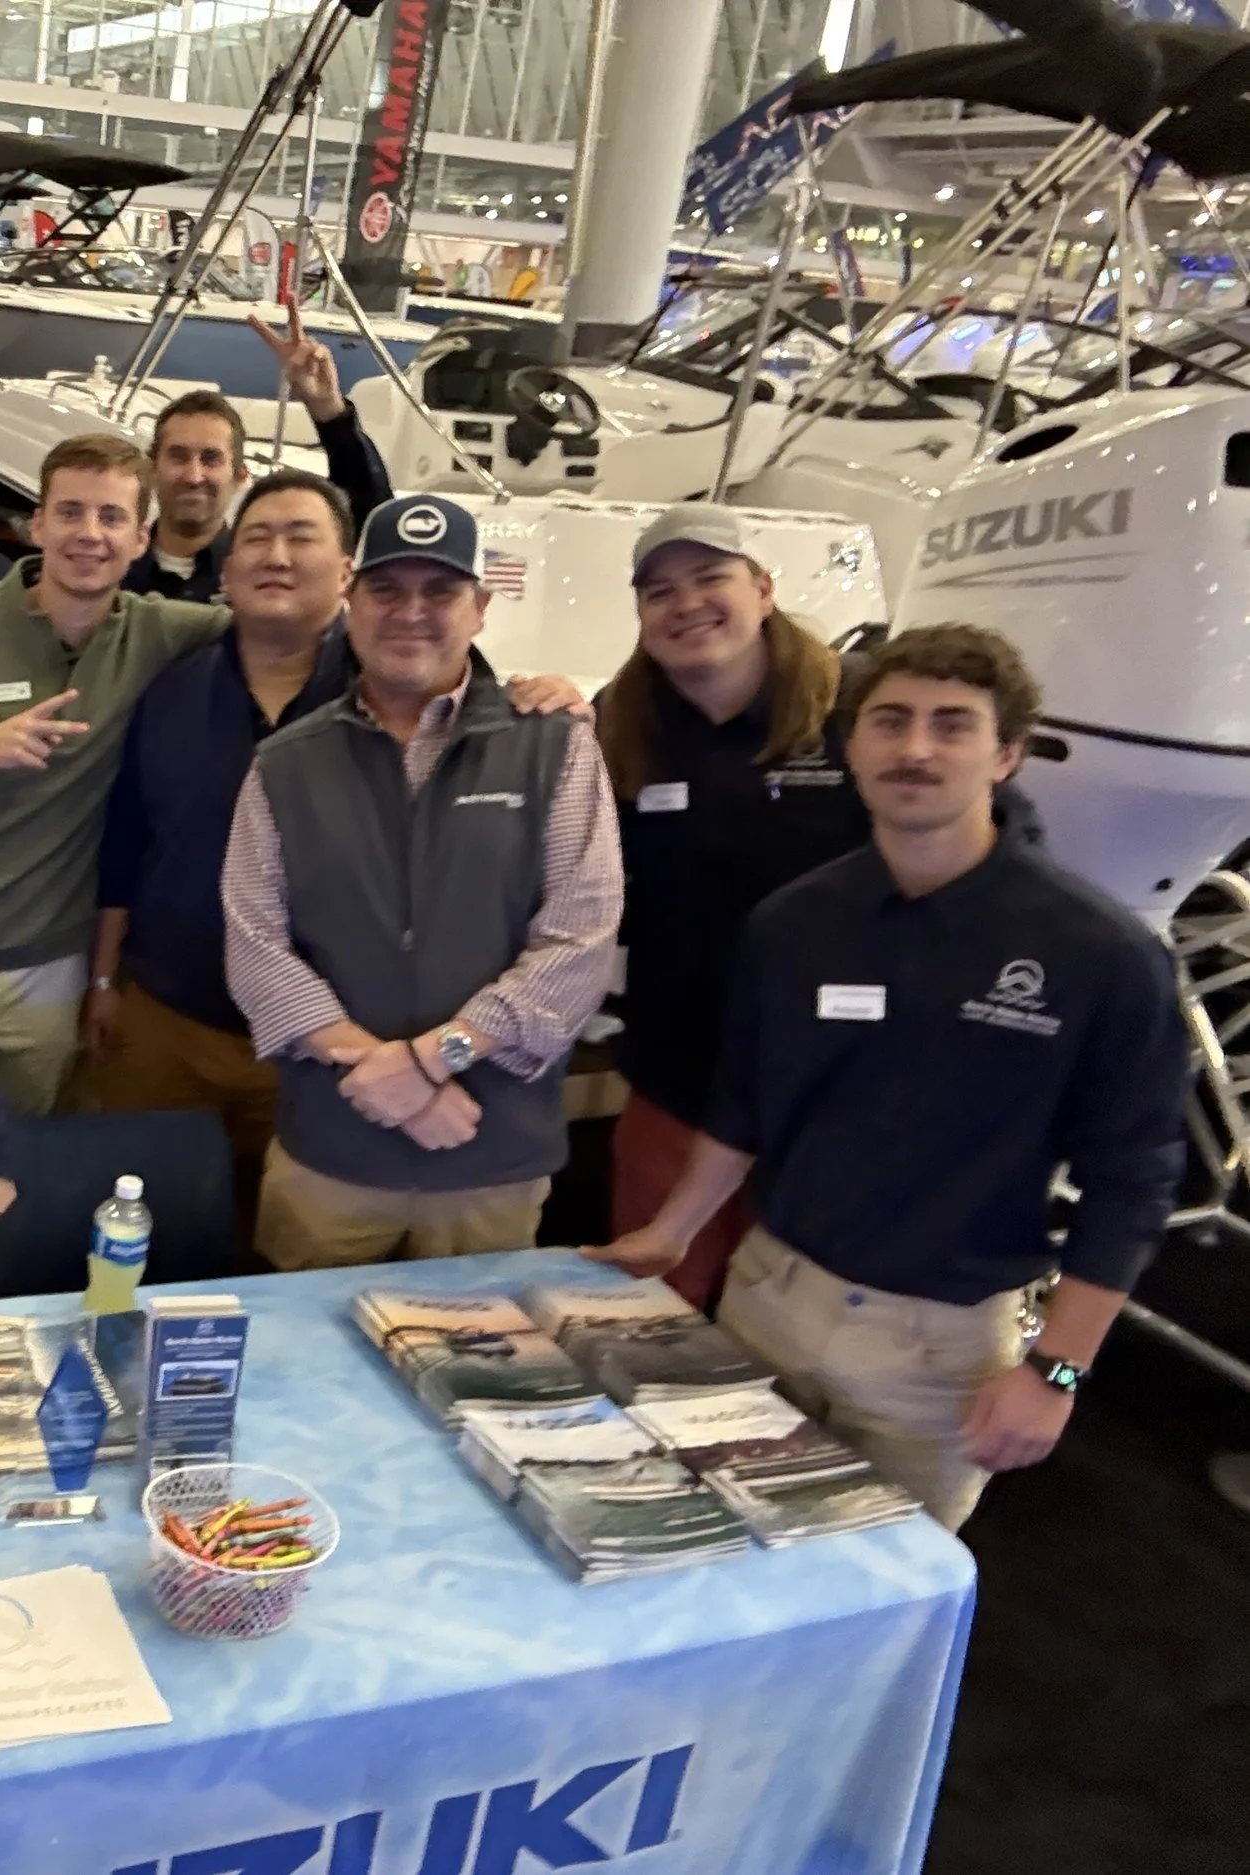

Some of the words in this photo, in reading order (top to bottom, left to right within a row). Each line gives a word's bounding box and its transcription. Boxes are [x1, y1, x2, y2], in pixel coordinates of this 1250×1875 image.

[370, 0, 429, 186] YAMAHA
[919, 487, 1134, 570] SUZUKI
[111, 1744, 694, 1875] UKI
